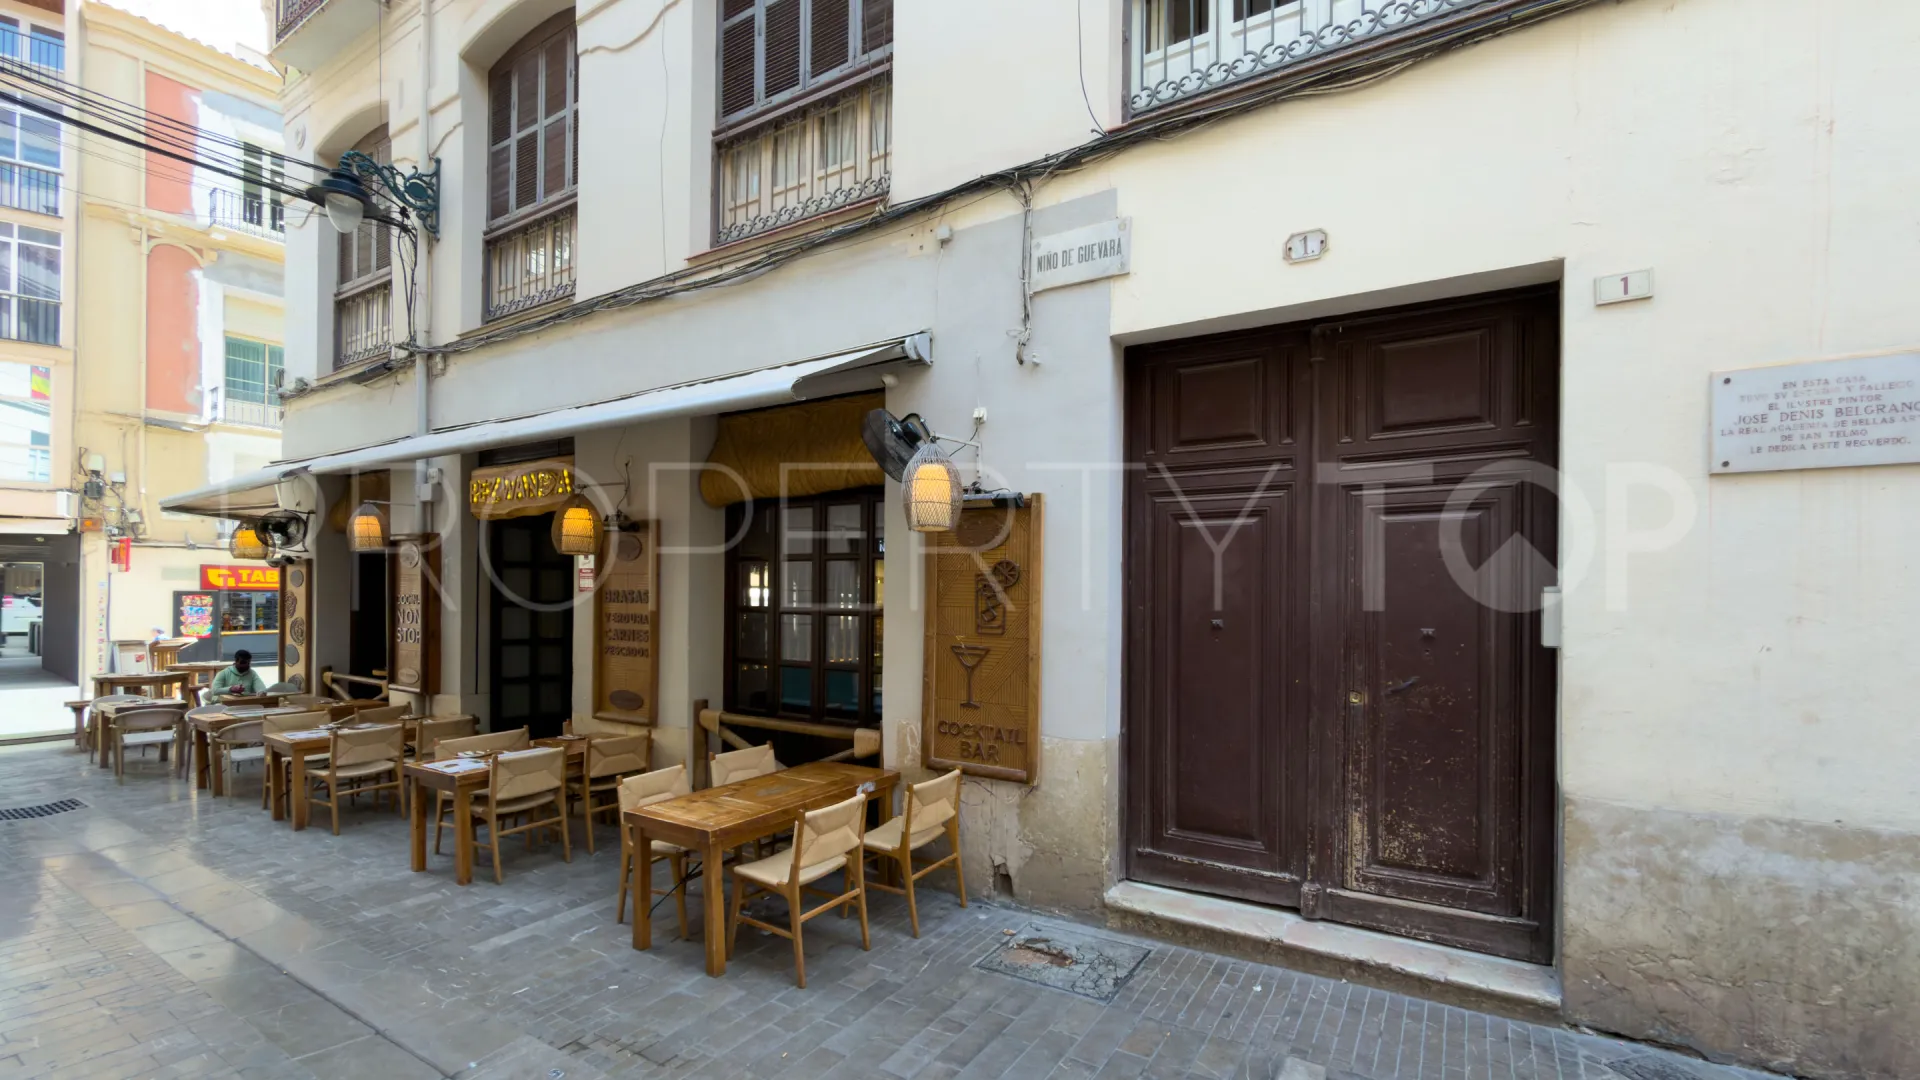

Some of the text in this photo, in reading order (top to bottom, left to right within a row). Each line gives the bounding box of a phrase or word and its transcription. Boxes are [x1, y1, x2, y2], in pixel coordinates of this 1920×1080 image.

[1036, 237, 1122, 273] NIÑO DE GUEVARA
[1620, 275, 1629, 296] 1
[1802, 378, 1830, 388] ESTA
[1767, 401, 1780, 411] EL
[1838, 394, 1883, 405] PINTOR
[1733, 413, 1769, 426] JOSE
[1779, 409, 1824, 422] DENIS
[1738, 426, 1767, 435] REAL
[1851, 416, 1895, 427] BELLAS
[604, 589, 650, 605] BRASAS
[604, 628, 650, 643] CARNES
[937, 720, 1027, 746] COCKTAIL
[960, 740, 1000, 762] BAR
